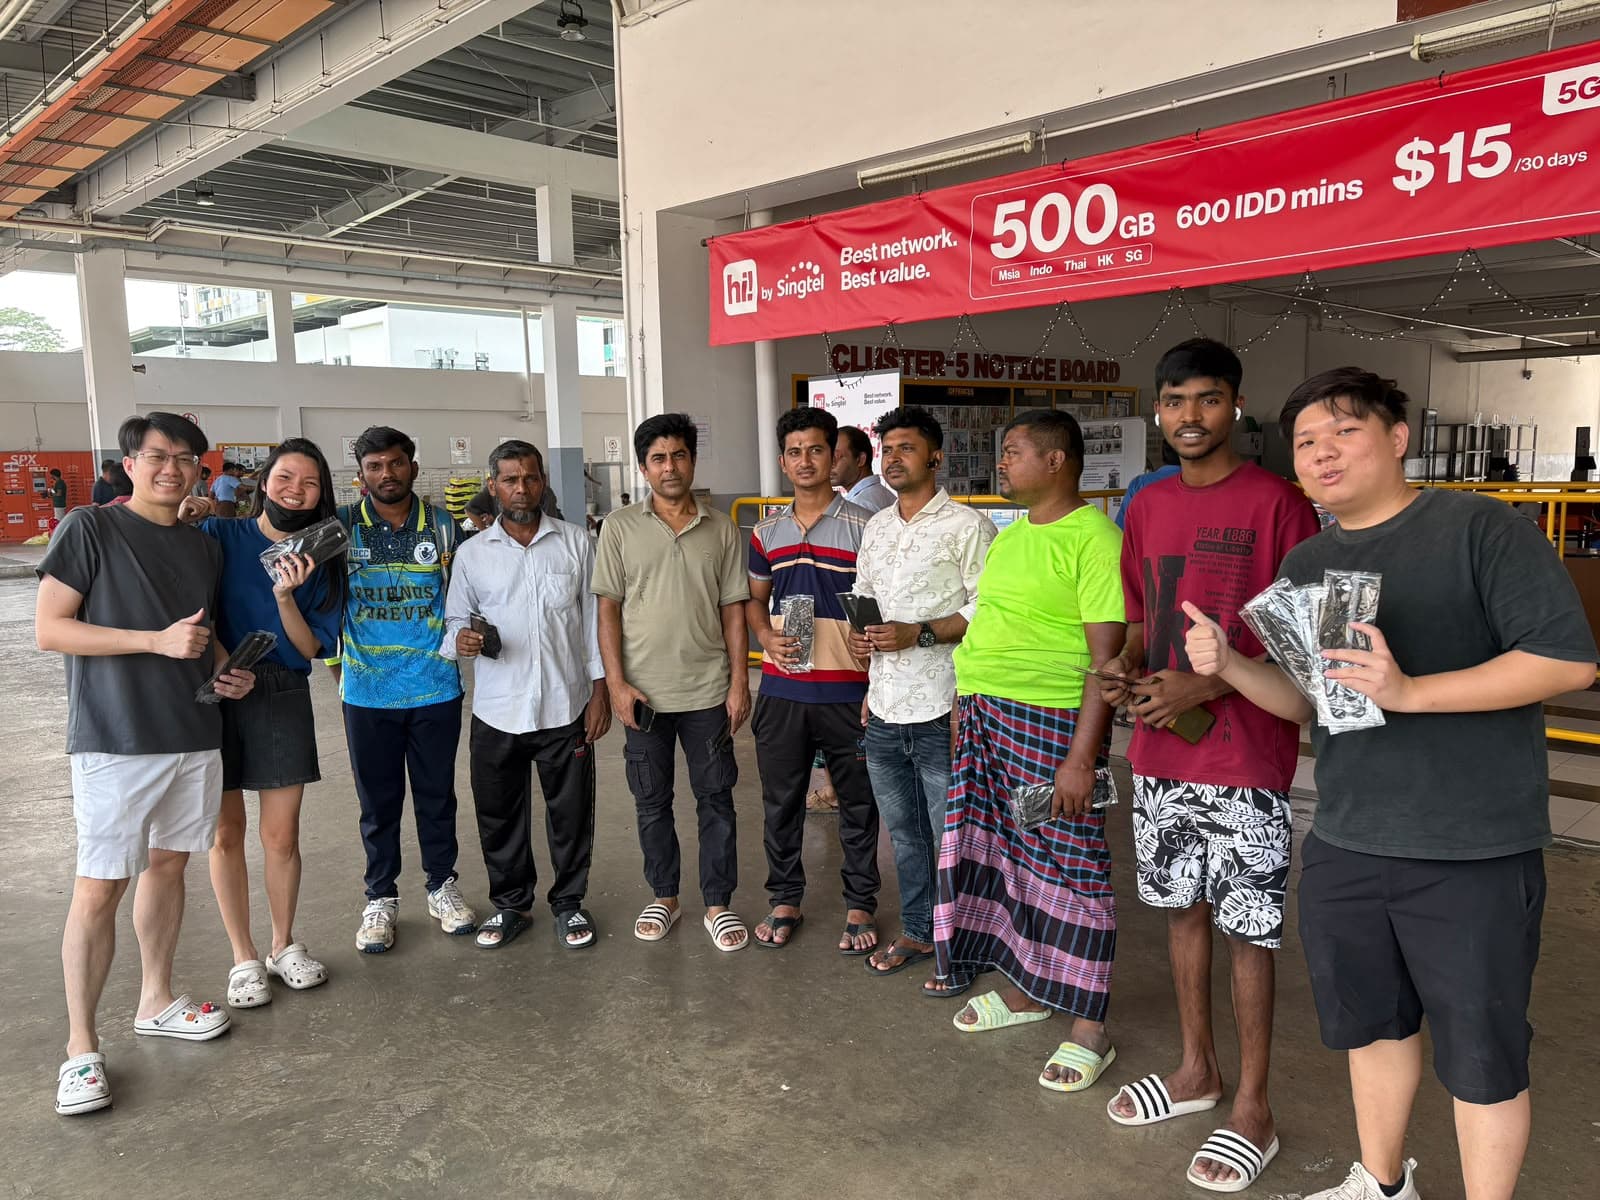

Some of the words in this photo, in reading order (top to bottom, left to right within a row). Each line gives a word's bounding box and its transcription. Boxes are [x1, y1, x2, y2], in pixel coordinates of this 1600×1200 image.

[1547, 151, 1588, 167] days
[1176, 198, 1230, 229] 600
[1235, 187, 1286, 219] IDD
[1291, 178, 1363, 210] mins
[840, 242, 878, 266] Best
[881, 227, 958, 260] network.
[840, 267, 877, 291] Best
[880, 262, 931, 284] value.
[998, 268, 1021, 281] Msia
[1030, 264, 1053, 276] Indo
[1064, 258, 1087, 271] Thai
[1097, 253, 1114, 267] HK
[1125, 249, 1143, 262] SG
[761, 287, 773, 301] by
[777, 273, 824, 299] Singtel
[831, 344, 970, 378] CLUSTER-5
[973, 353, 1056, 381] NOTICE
[1059, 359, 1121, 383] BOARD
[11, 454, 37, 464] SPX
[1196, 527, 1220, 539] YEAR
